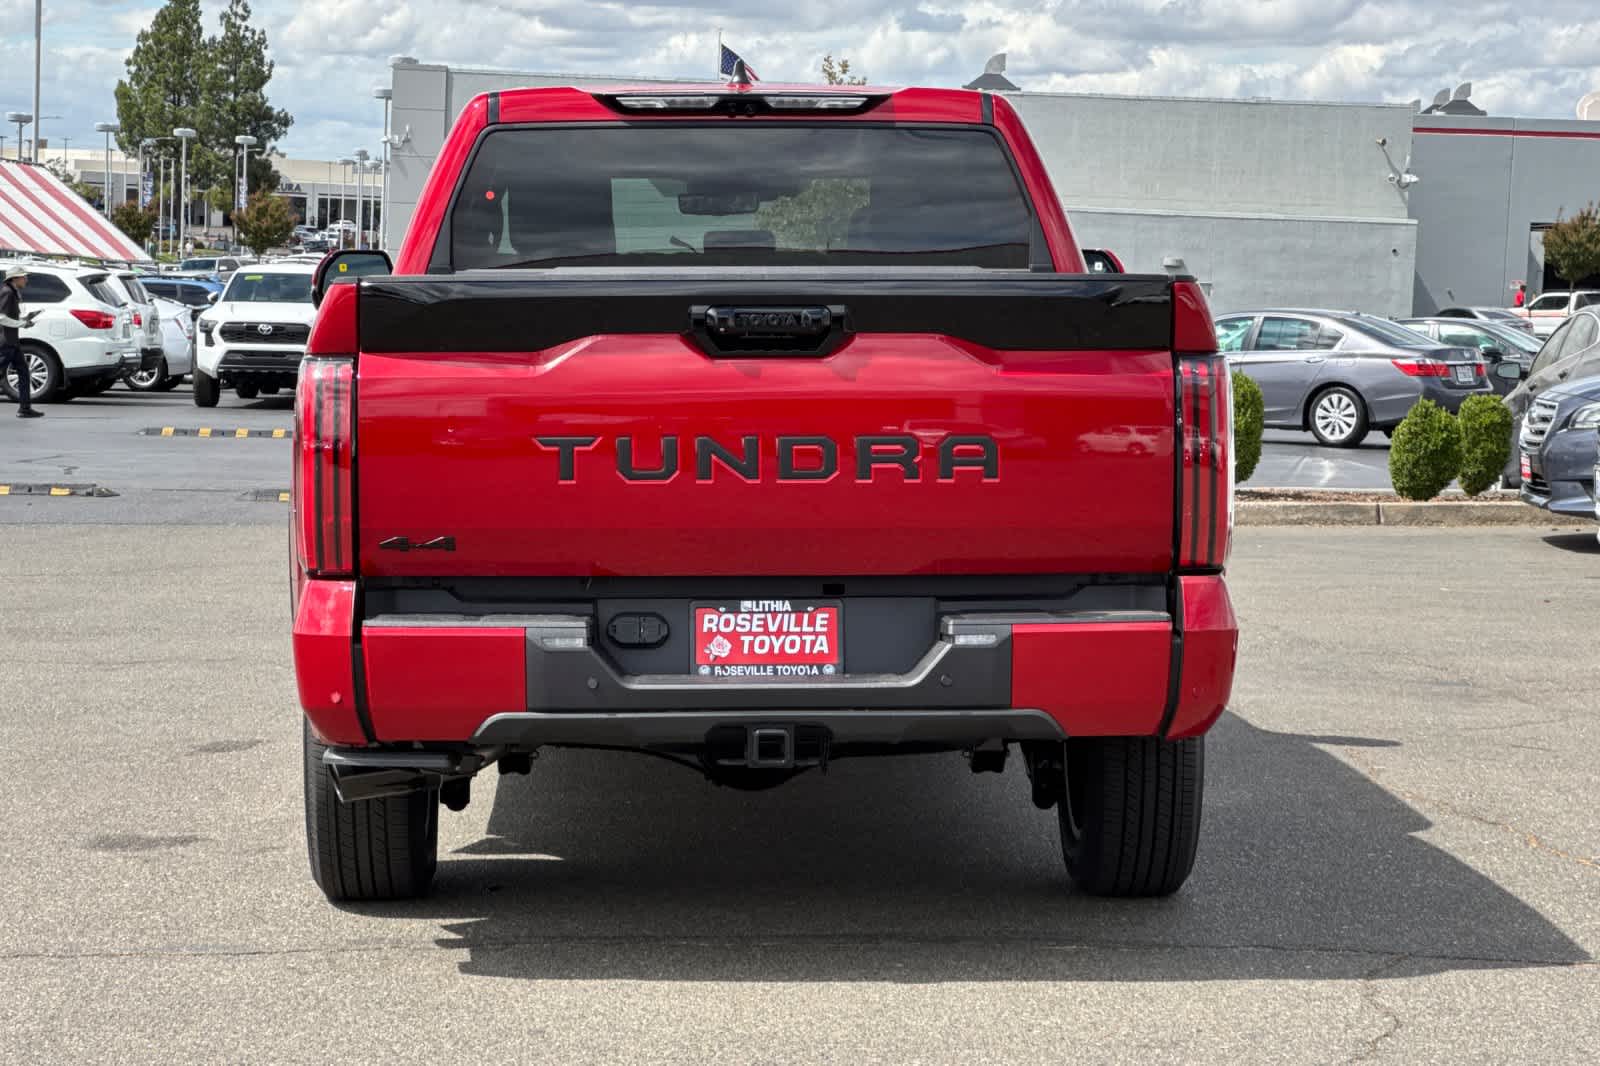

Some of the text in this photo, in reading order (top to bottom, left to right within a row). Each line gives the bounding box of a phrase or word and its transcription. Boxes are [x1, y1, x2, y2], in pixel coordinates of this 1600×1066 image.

[532, 435, 1002, 485] TUNDRA
[752, 600, 792, 612] LITHIA
[702, 613, 830, 633] ROSEVILLE
[740, 635, 829, 655] TOYOTA
[714, 665, 774, 676] ROSEVILLE
